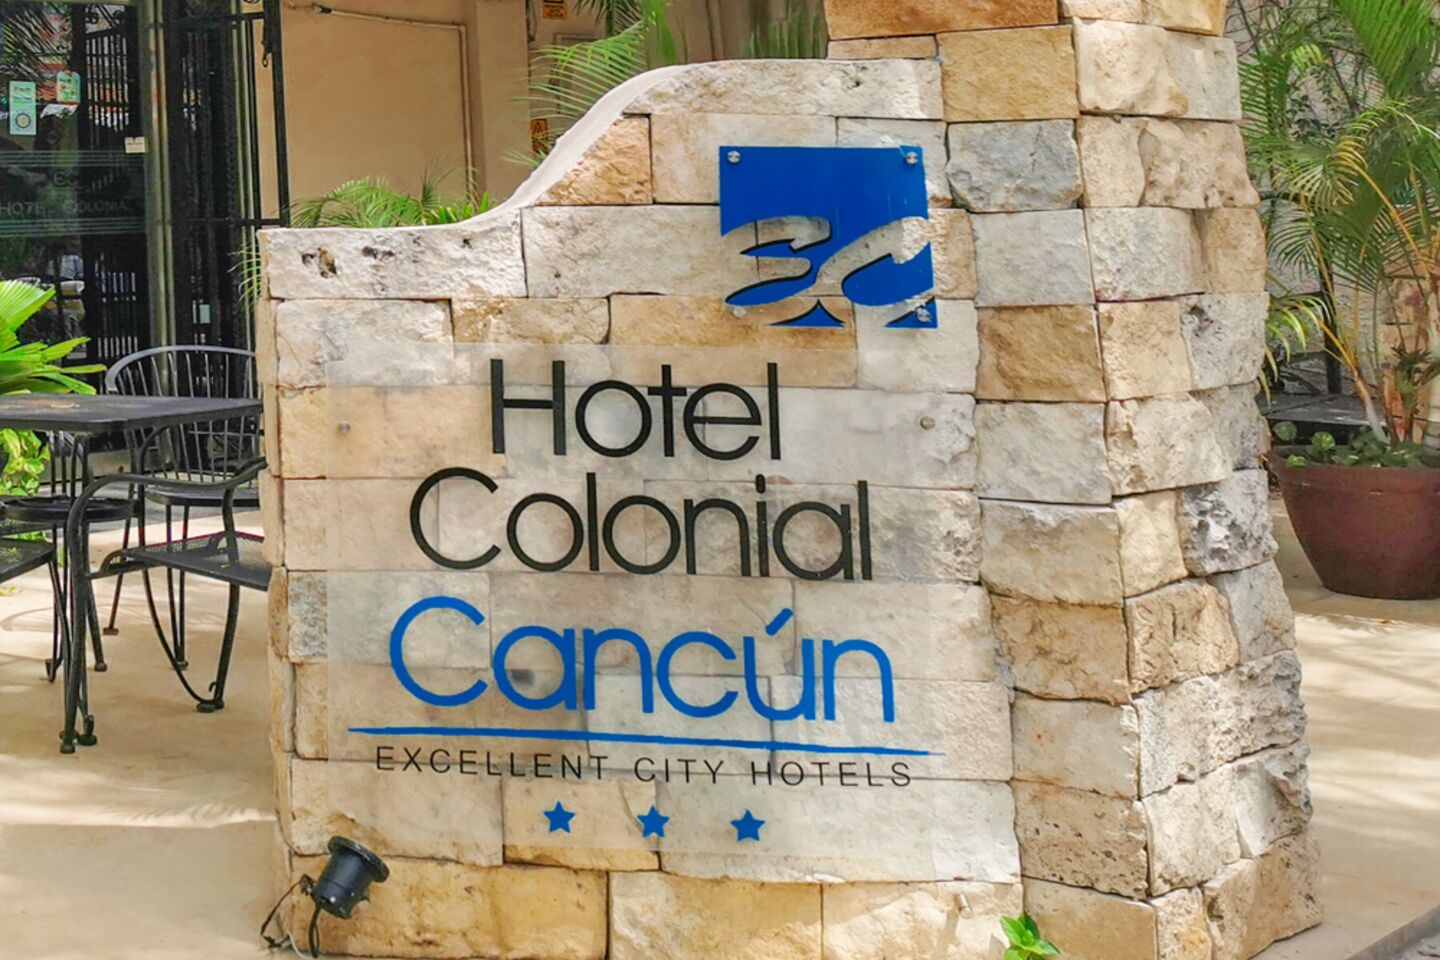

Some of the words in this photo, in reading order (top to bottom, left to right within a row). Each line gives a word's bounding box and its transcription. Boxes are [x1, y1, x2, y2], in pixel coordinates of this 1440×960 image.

[490, 358, 781, 461] Hotel
[409, 467, 874, 581] Colonial
[389, 595, 896, 724] Cancún
[374, 744, 612, 782] EXCELLENT
[633, 754, 726, 785] CITY
[750, 759, 914, 788] HOTELS
